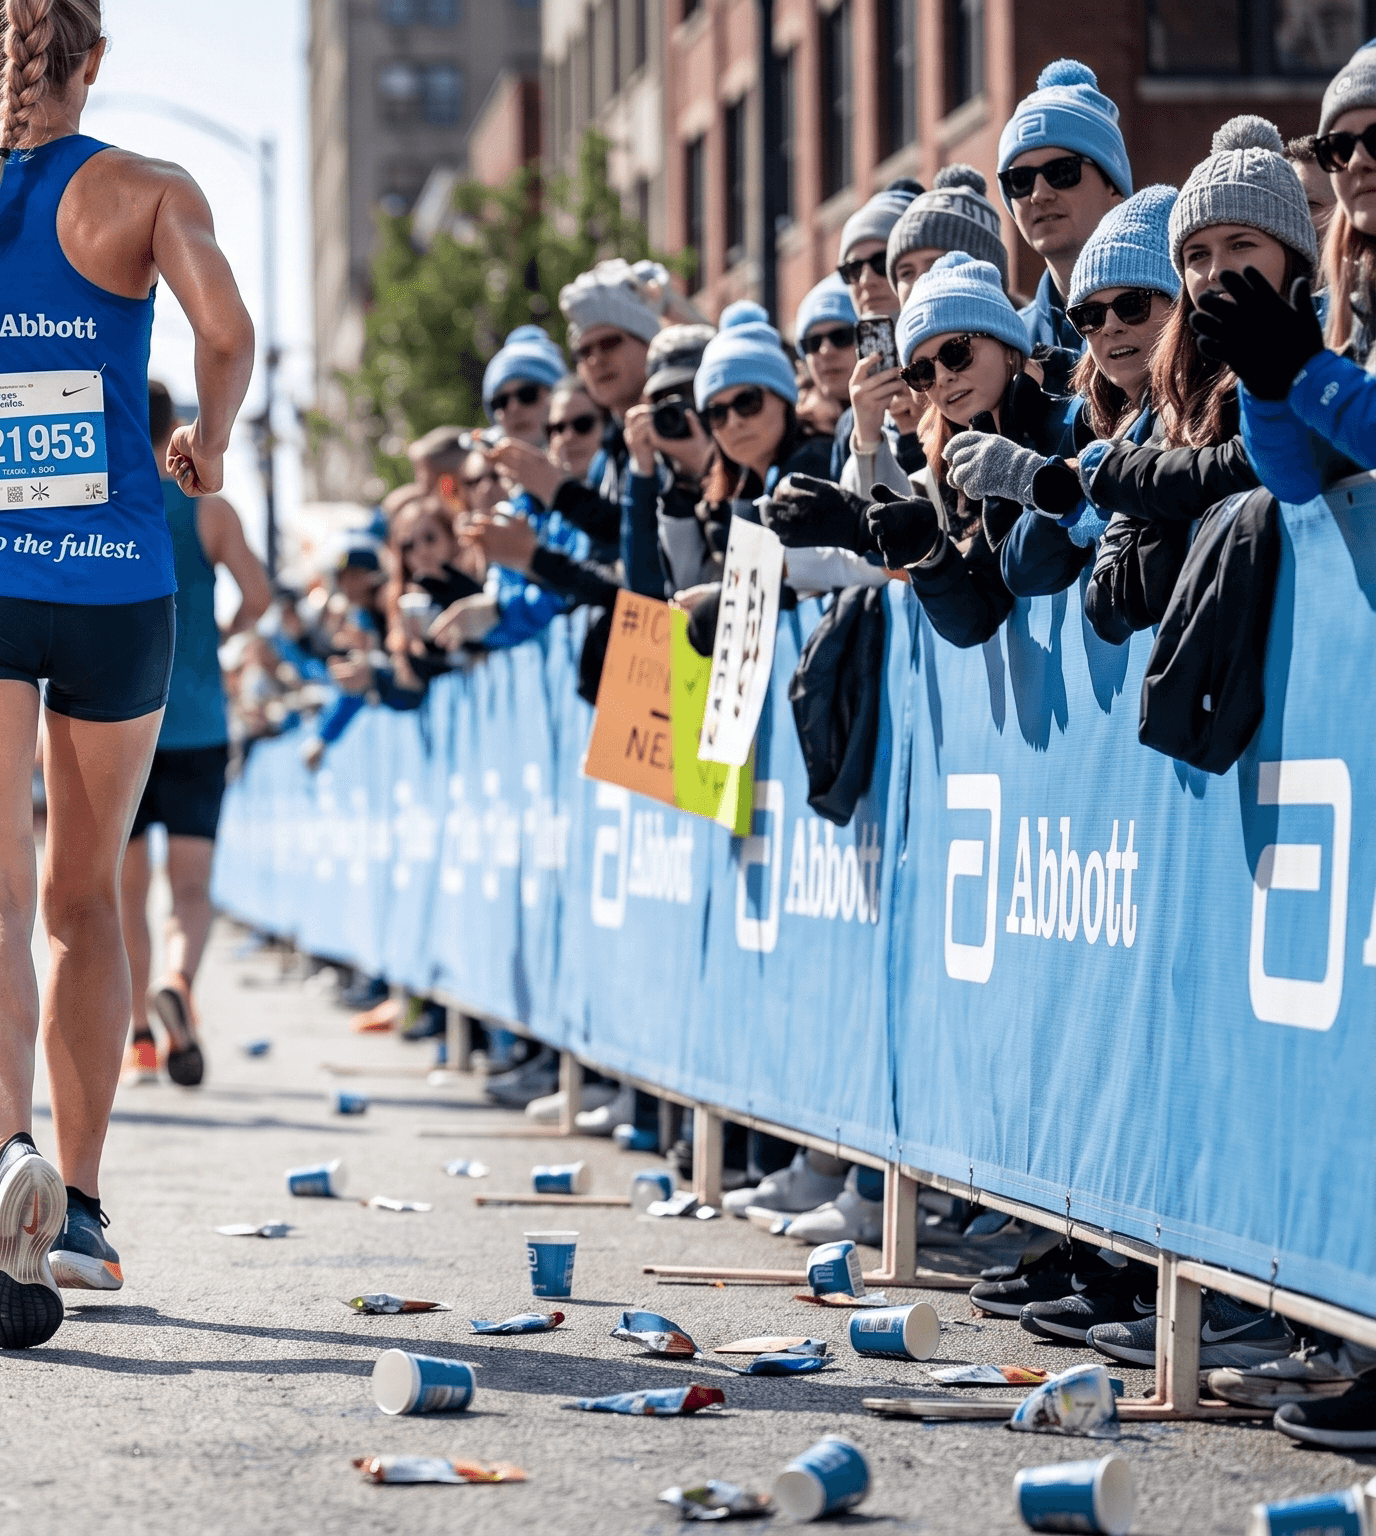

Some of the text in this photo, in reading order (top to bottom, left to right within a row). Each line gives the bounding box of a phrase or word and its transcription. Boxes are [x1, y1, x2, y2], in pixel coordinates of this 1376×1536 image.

[13, 533, 53, 556] the
[53, 533, 141, 563] fullest.
[784, 816, 881, 926] Abbott
[1006, 816, 1138, 948] Abbott
